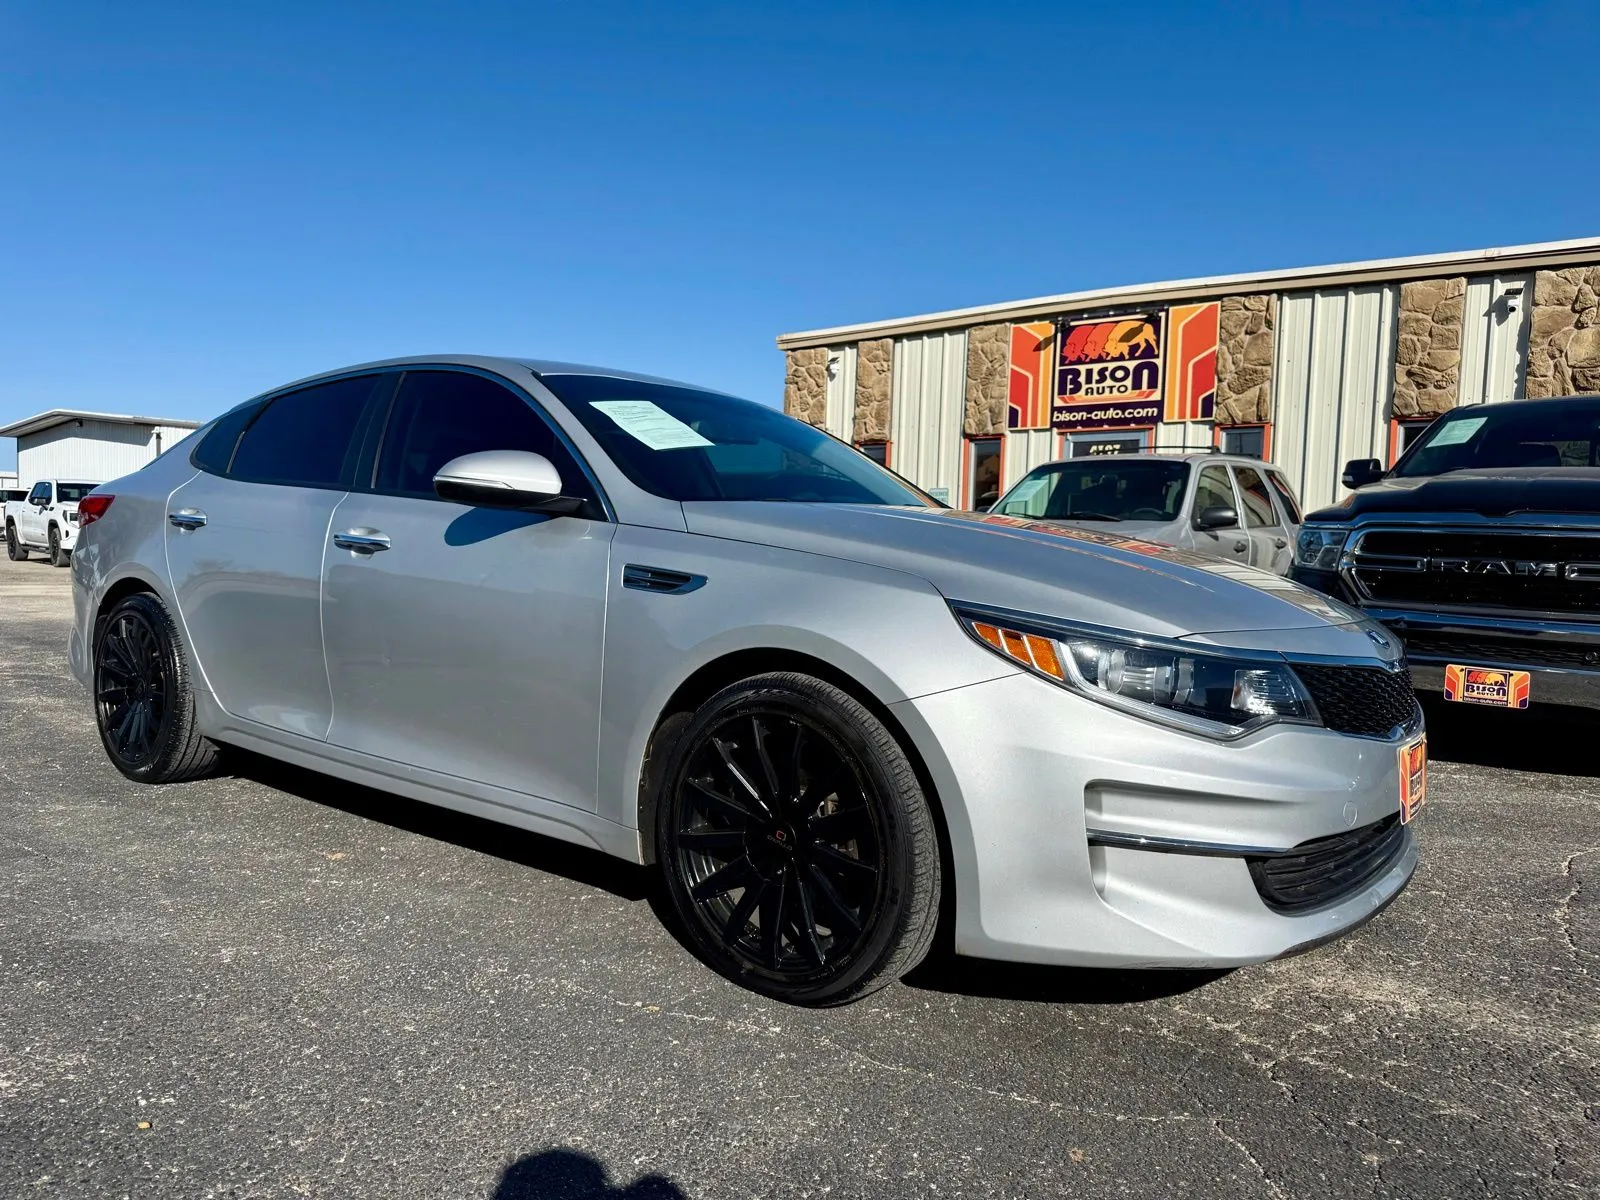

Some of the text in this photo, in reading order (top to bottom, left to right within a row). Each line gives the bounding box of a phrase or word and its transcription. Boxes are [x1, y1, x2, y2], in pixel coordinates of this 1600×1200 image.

[1057, 361, 1159, 396] BISON
[1085, 385, 1128, 396] AUTO
[1053, 407, 1158, 422] bison-auto.com
[1432, 558, 1557, 577] RAM
[1465, 684, 1507, 697] BISON
